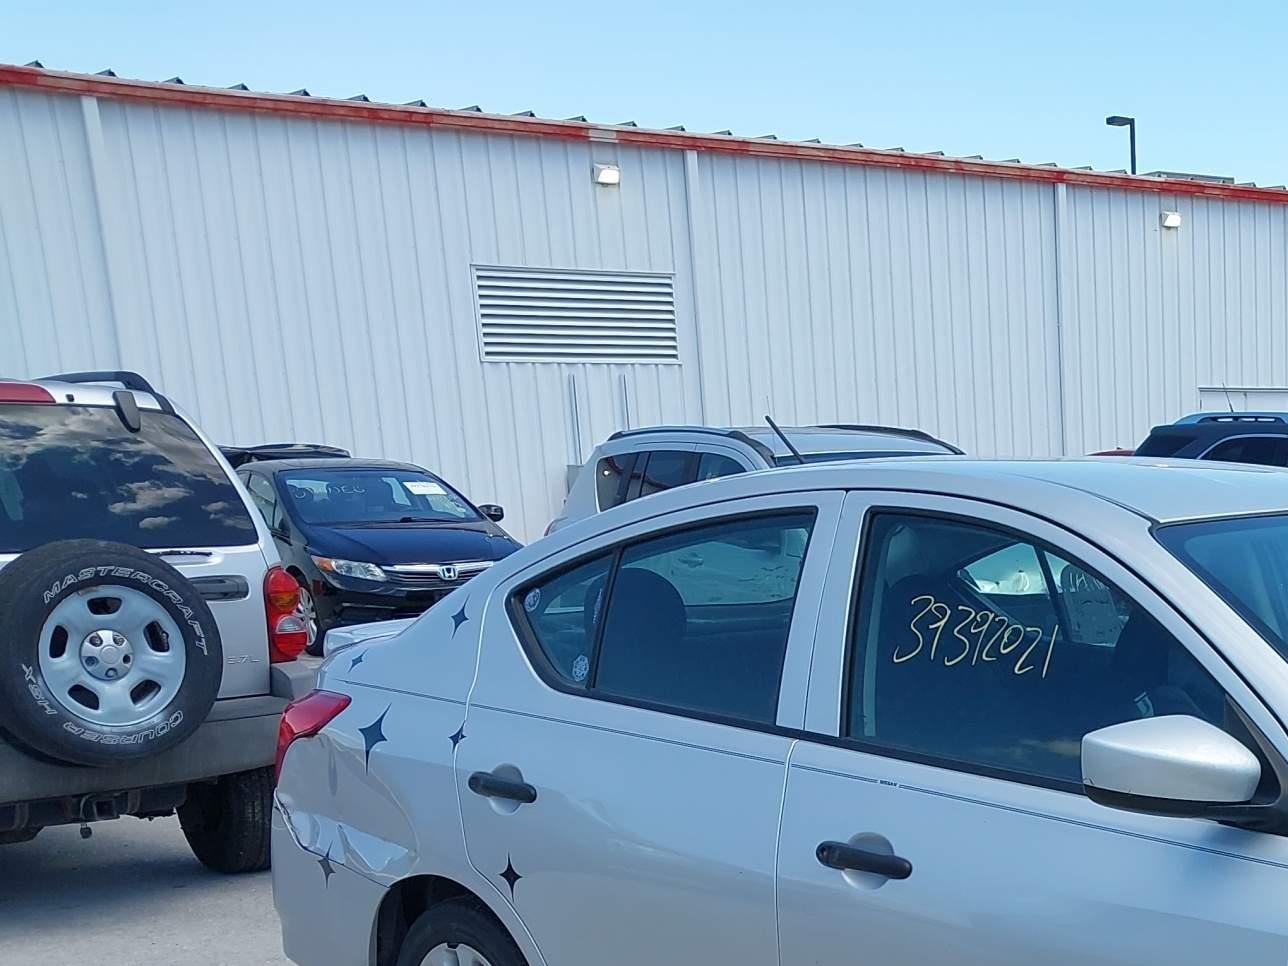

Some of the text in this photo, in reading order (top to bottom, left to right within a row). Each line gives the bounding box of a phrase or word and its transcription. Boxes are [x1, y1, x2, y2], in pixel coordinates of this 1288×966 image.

[43, 565, 208, 656] MASTERCRAFT
[893, 595, 1060, 680] 39392021
[63, 710, 184, 745] COURSER
